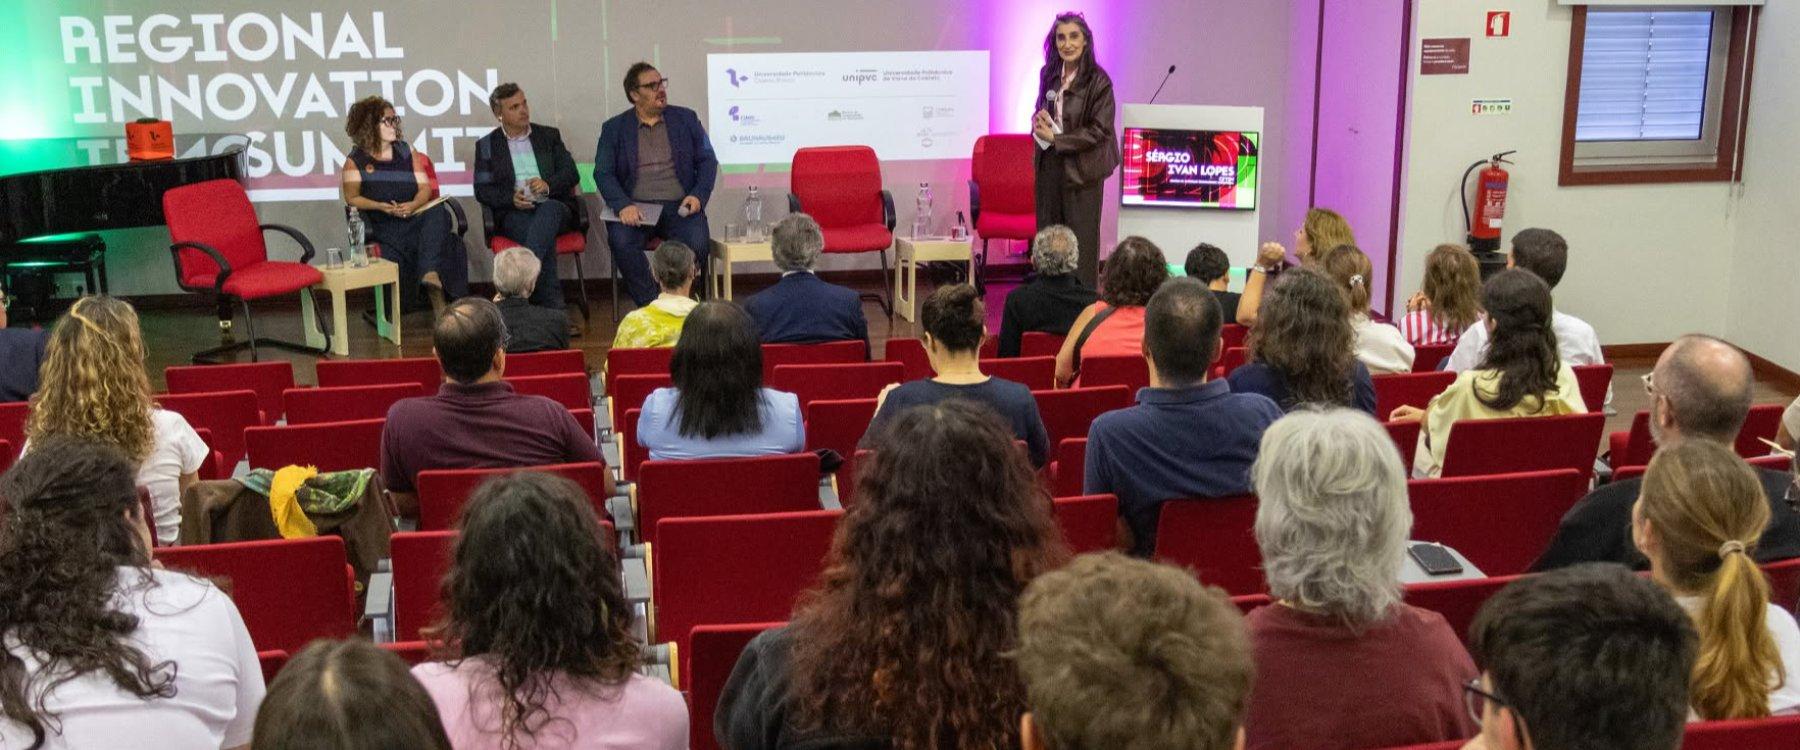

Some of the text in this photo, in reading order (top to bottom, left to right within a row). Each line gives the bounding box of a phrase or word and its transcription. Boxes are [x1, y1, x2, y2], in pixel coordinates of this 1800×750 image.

[60, 11, 404, 63] REGIONAL
[842, 70, 877, 86] unipvc
[69, 68, 498, 124] INNOVATION
[248, 126, 497, 179] SUMI
[1146, 149, 1190, 163] SÉRGIO
[1168, 164, 1234, 177] IVAN LOPES
